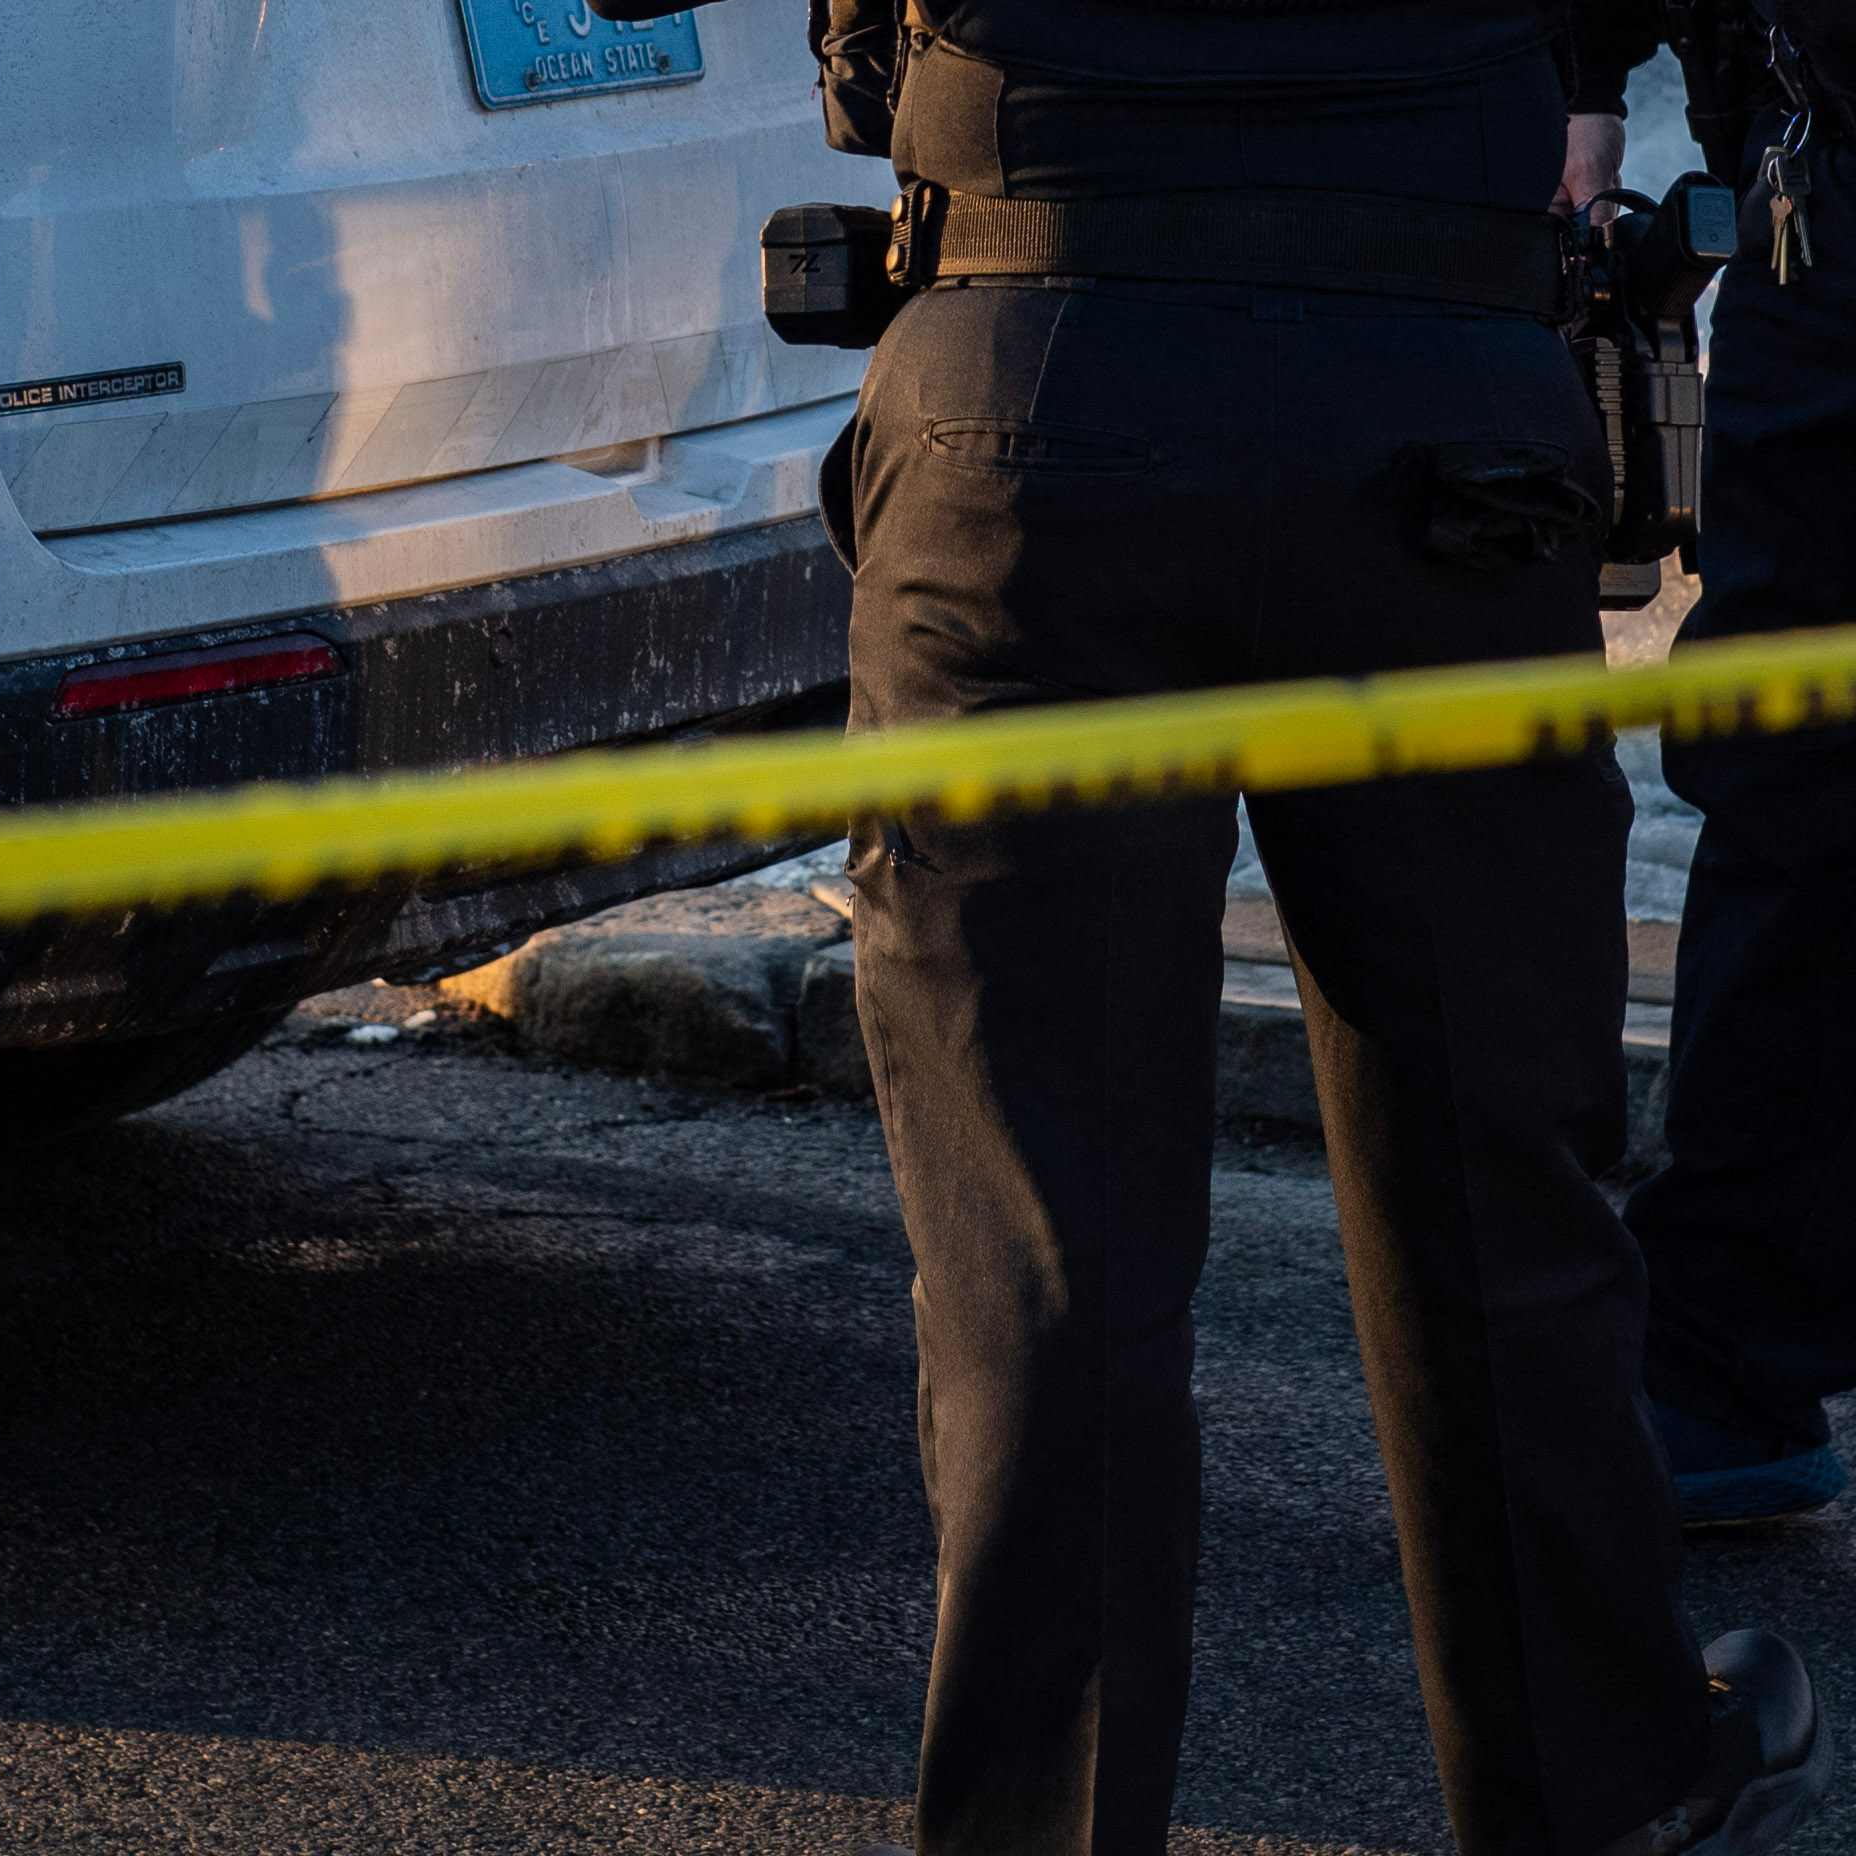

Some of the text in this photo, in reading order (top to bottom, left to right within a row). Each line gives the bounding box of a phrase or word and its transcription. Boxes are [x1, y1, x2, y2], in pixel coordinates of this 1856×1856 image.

[535, 42, 657, 82] OCEAN STATE
[58, 370, 180, 401] INTERCEPTOR
